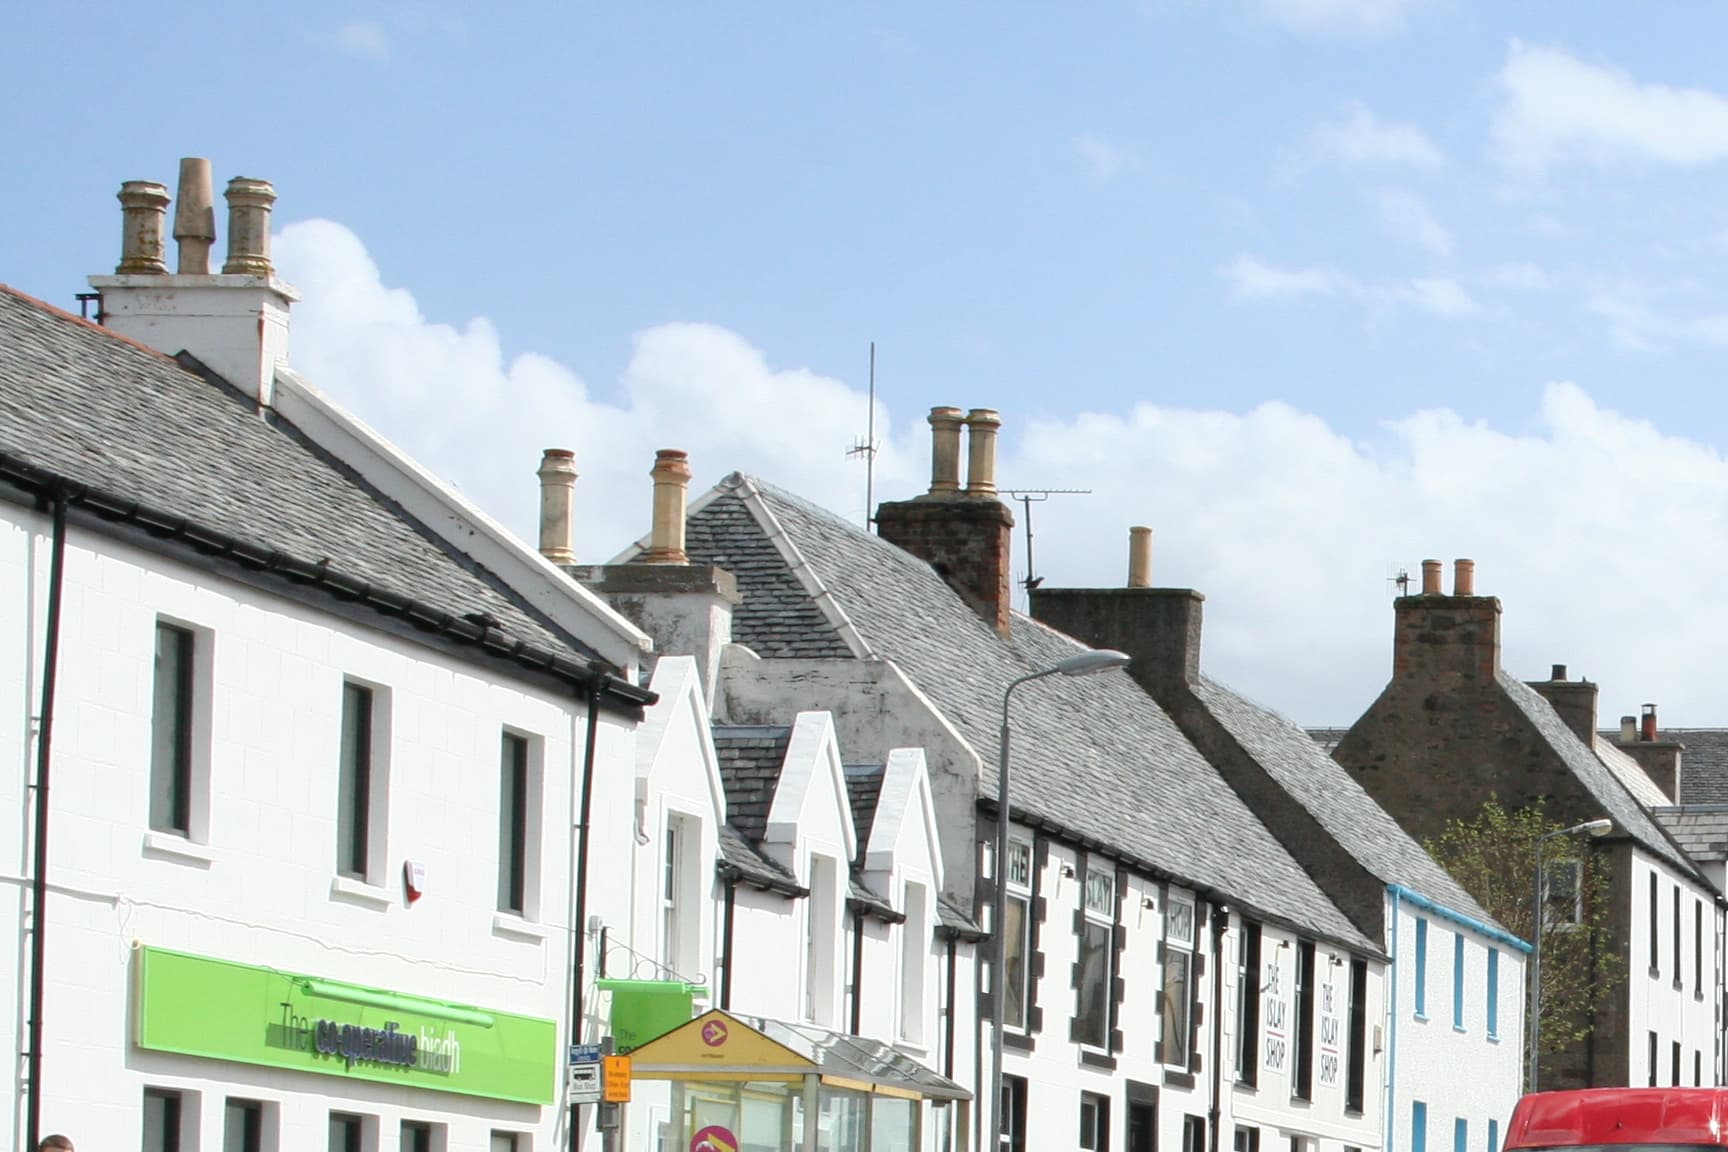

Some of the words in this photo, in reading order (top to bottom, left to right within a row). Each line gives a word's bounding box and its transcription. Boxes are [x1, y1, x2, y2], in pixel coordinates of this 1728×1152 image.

[1086, 872, 1110, 914] SLAY
[1266, 963, 1280, 996] THE
[1266, 997, 1287, 1031] ISLAY
[1321, 983, 1334, 1014] THE
[279, 1001, 310, 1050] The
[313, 1019, 417, 1070] co-operative
[420, 1024, 461, 1073] biadh
[1320, 1015, 1340, 1047] ISLAY
[1265, 1037, 1286, 1070] SHOP
[1320, 1053, 1338, 1084] SHOP
